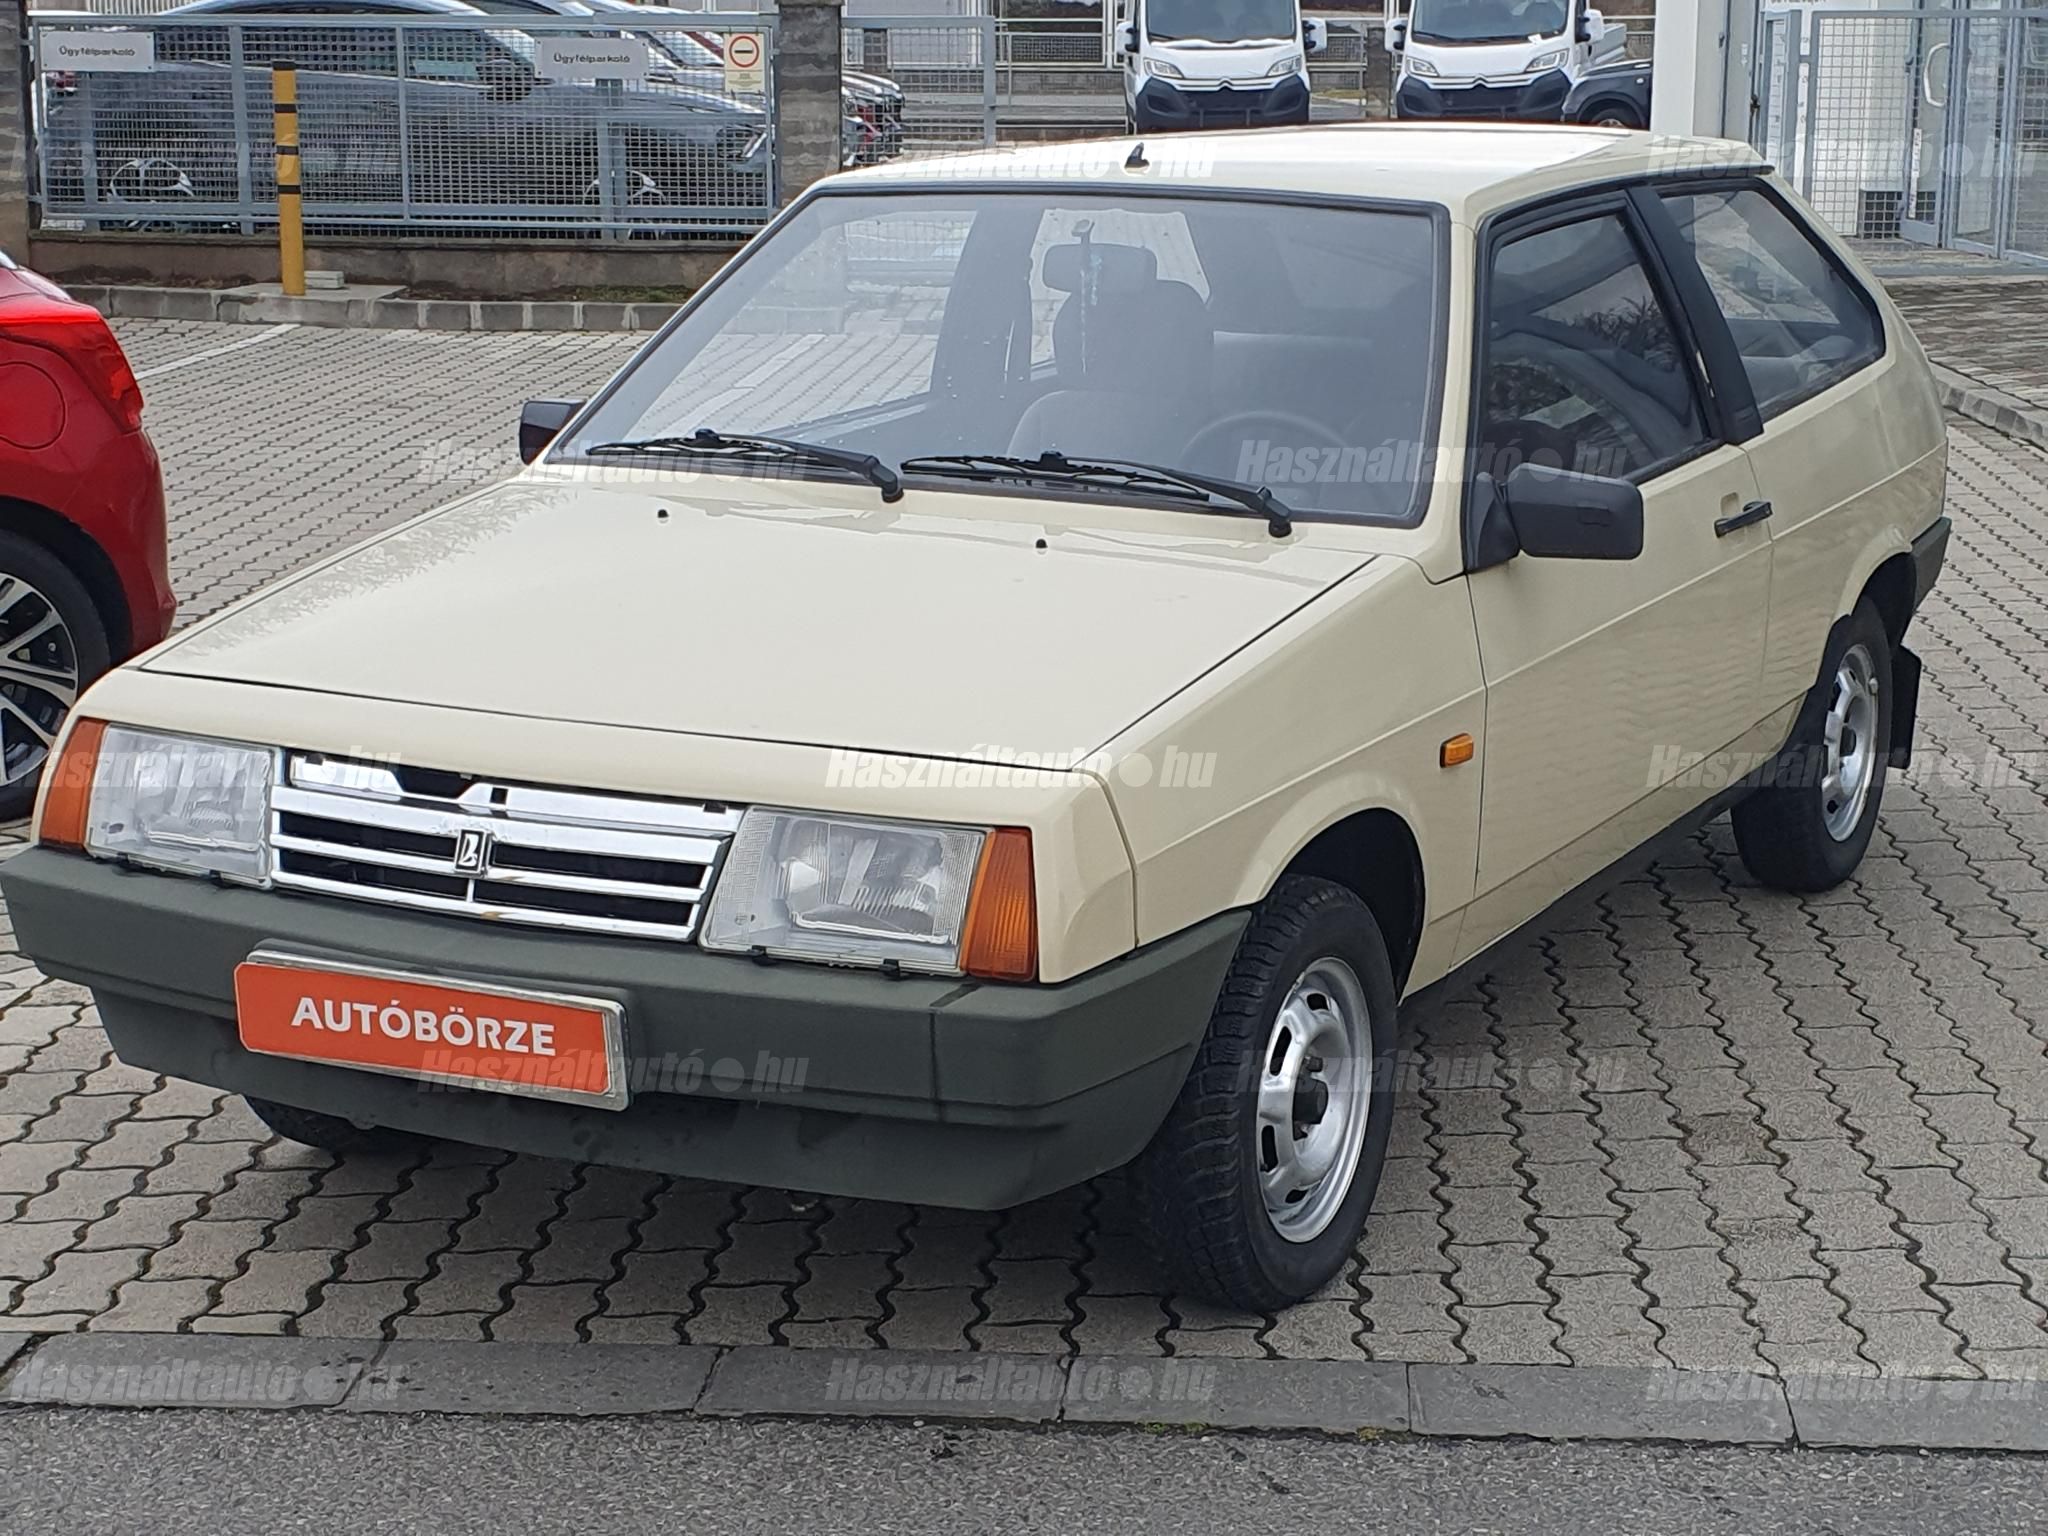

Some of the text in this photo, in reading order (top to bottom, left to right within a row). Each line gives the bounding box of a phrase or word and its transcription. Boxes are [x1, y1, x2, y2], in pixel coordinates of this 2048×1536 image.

[59, 45, 135, 57] Ügyfélparkoló
[553, 52, 630, 64] Ügyfélparkoló
[291, 997, 556, 1057] AUTÓBÖRZE
